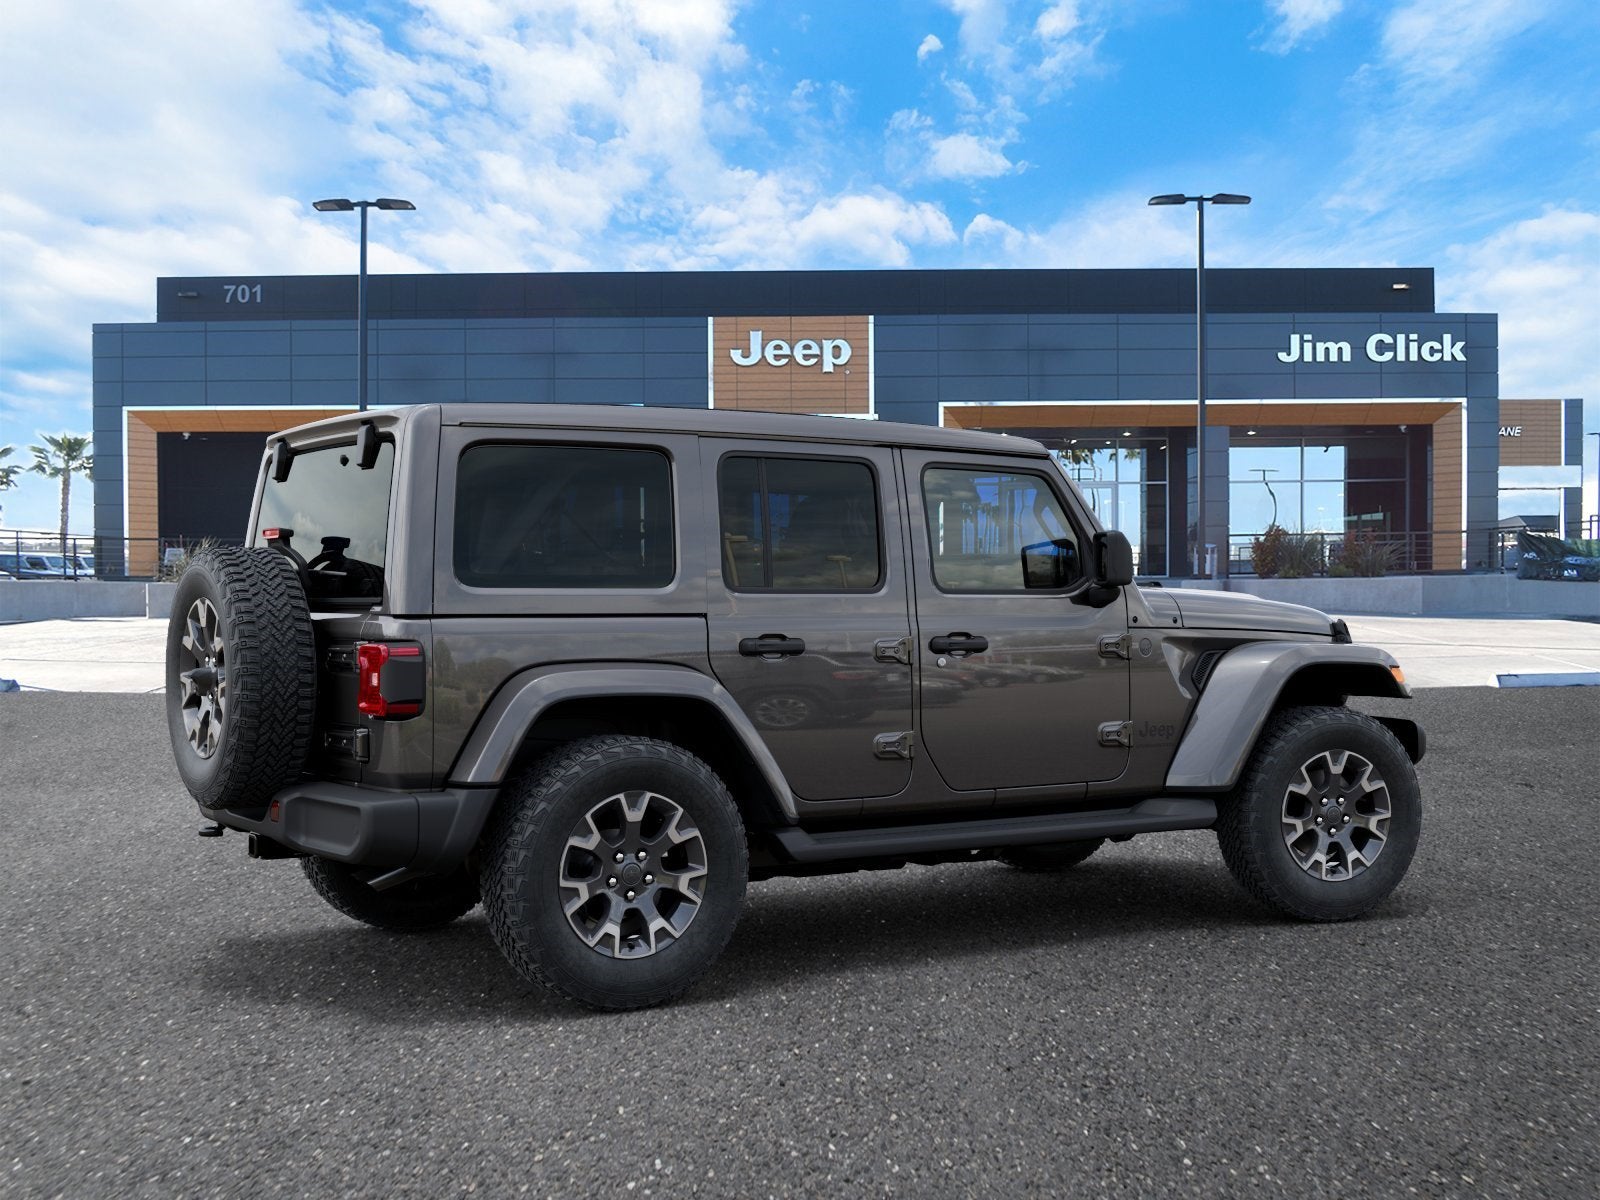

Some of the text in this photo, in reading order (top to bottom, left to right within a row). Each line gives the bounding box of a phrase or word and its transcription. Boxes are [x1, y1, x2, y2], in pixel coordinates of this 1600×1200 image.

[223, 284, 263, 304] 701
[729, 329, 852, 374] Jeep
[1277, 333, 1468, 363] Jim Click
[1139, 720, 1175, 740] Jeep
